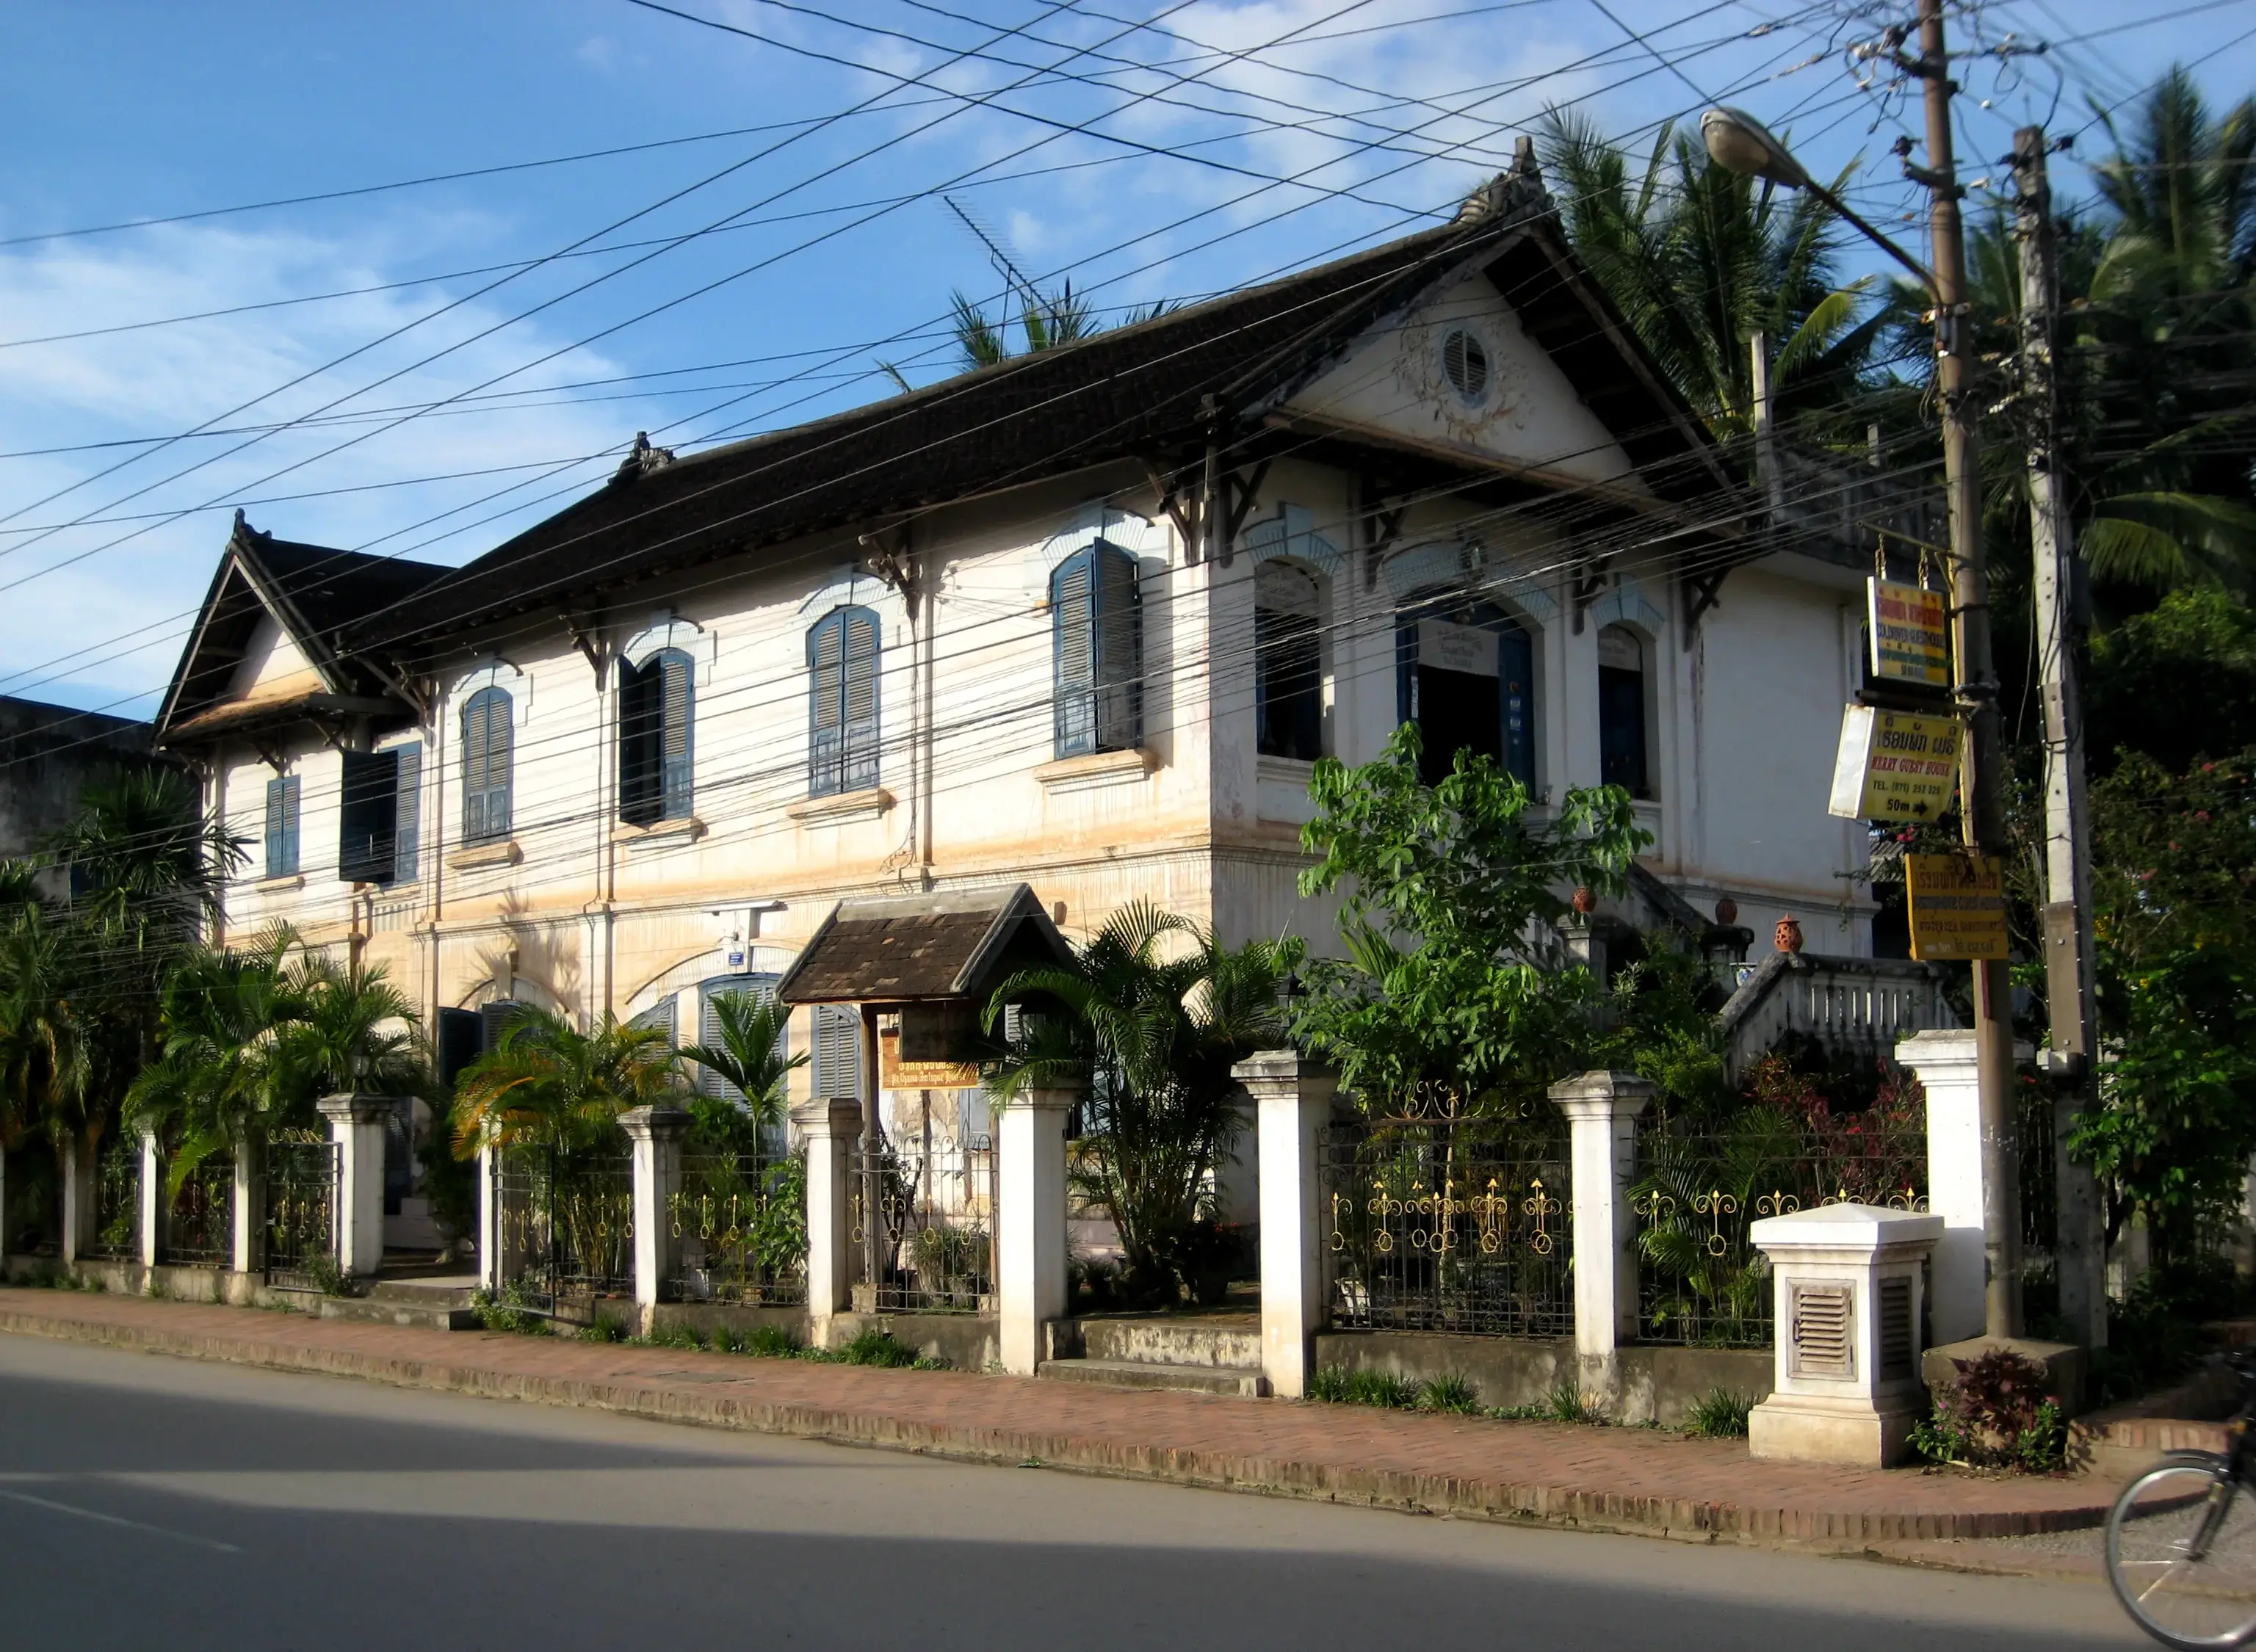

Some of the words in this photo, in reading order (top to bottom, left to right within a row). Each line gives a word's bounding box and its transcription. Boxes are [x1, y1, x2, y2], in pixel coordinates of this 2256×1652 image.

[1899, 758, 1925, 774] GUEST
[1926, 761, 1951, 777] HOUSE
[1873, 780, 1888, 790] TEL.
[1886, 799, 1909, 811] 50m
